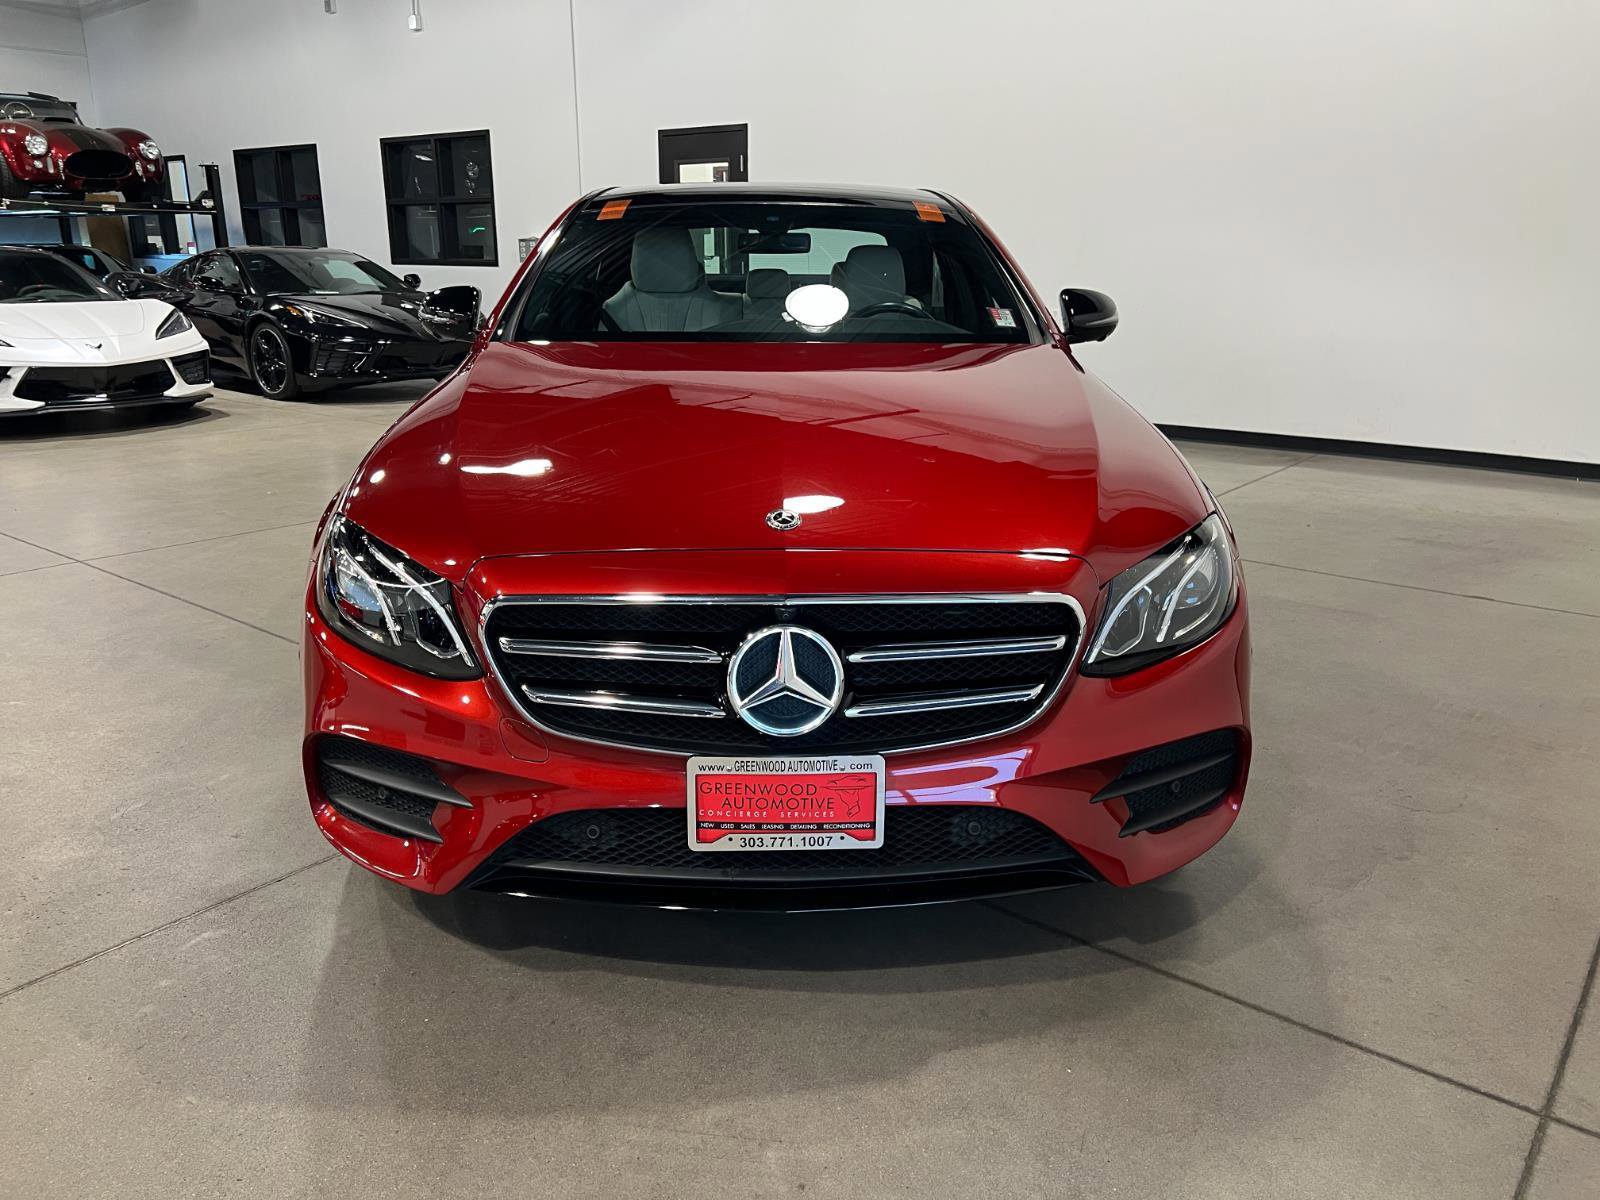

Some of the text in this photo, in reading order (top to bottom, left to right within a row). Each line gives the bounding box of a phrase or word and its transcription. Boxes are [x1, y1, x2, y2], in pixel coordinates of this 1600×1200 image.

[734, 760, 786, 772] GREENWOOD
[787, 759, 838, 772] AUTOMOTIVE
[700, 781, 817, 796] GREENWOOD
[721, 797, 835, 810] AUTOMOTIVE
[699, 809, 767, 818] CONCIERGE
[823, 822, 871, 830] RECONDITIONING
[739, 836, 833, 848] 303.771.1007
